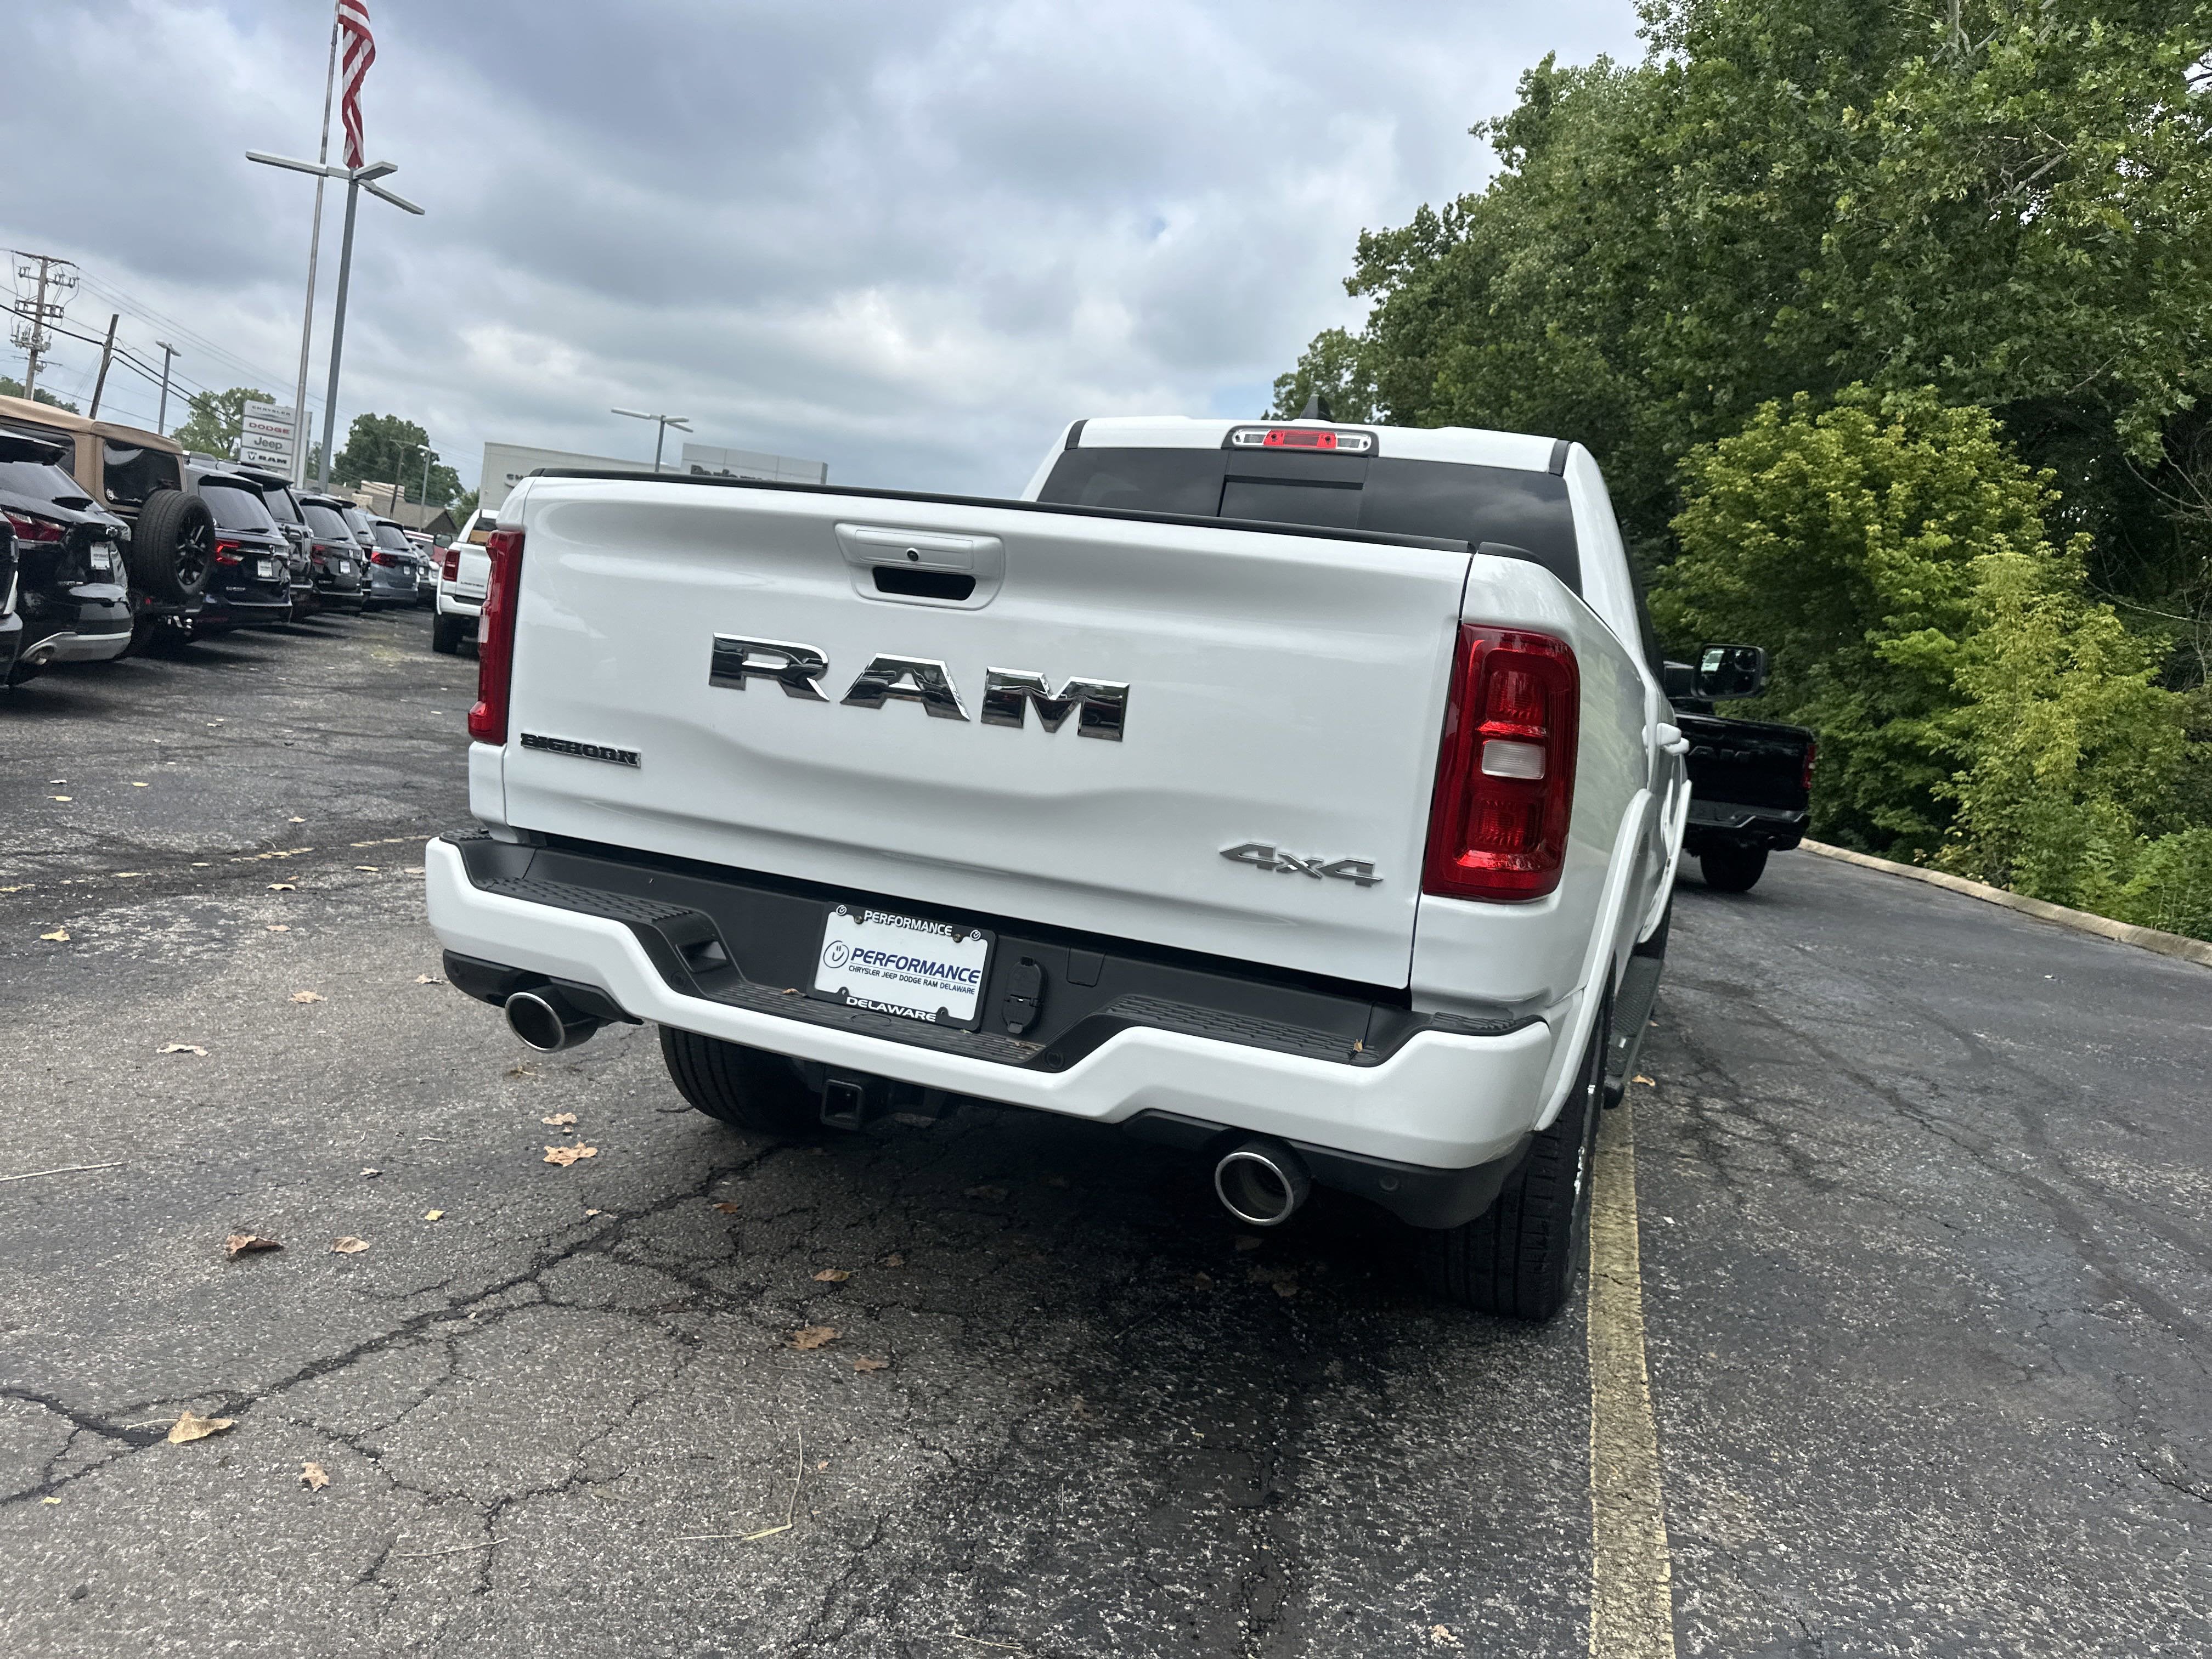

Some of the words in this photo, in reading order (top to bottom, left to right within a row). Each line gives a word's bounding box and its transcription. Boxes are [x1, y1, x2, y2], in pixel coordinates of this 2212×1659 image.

[252, 406, 290, 416] CHRYSLER
[249, 422, 290, 434] DODGE
[254, 437, 283, 450] Jeep
[258, 455, 287, 464] RAM
[709, 632, 1130, 742] RAM
[864, 910, 953, 936] PERFORMANCE
[851, 947, 981, 984] PERFORMANCE
[849, 964, 880, 977] CHRYSLER
[881, 971, 897, 979] JEEP
[899, 974, 922, 984] DODGE
[923, 979, 938, 988] RAM
[940, 982, 975, 995] DELAWARE
[846, 996, 936, 1022] DELAWARE
